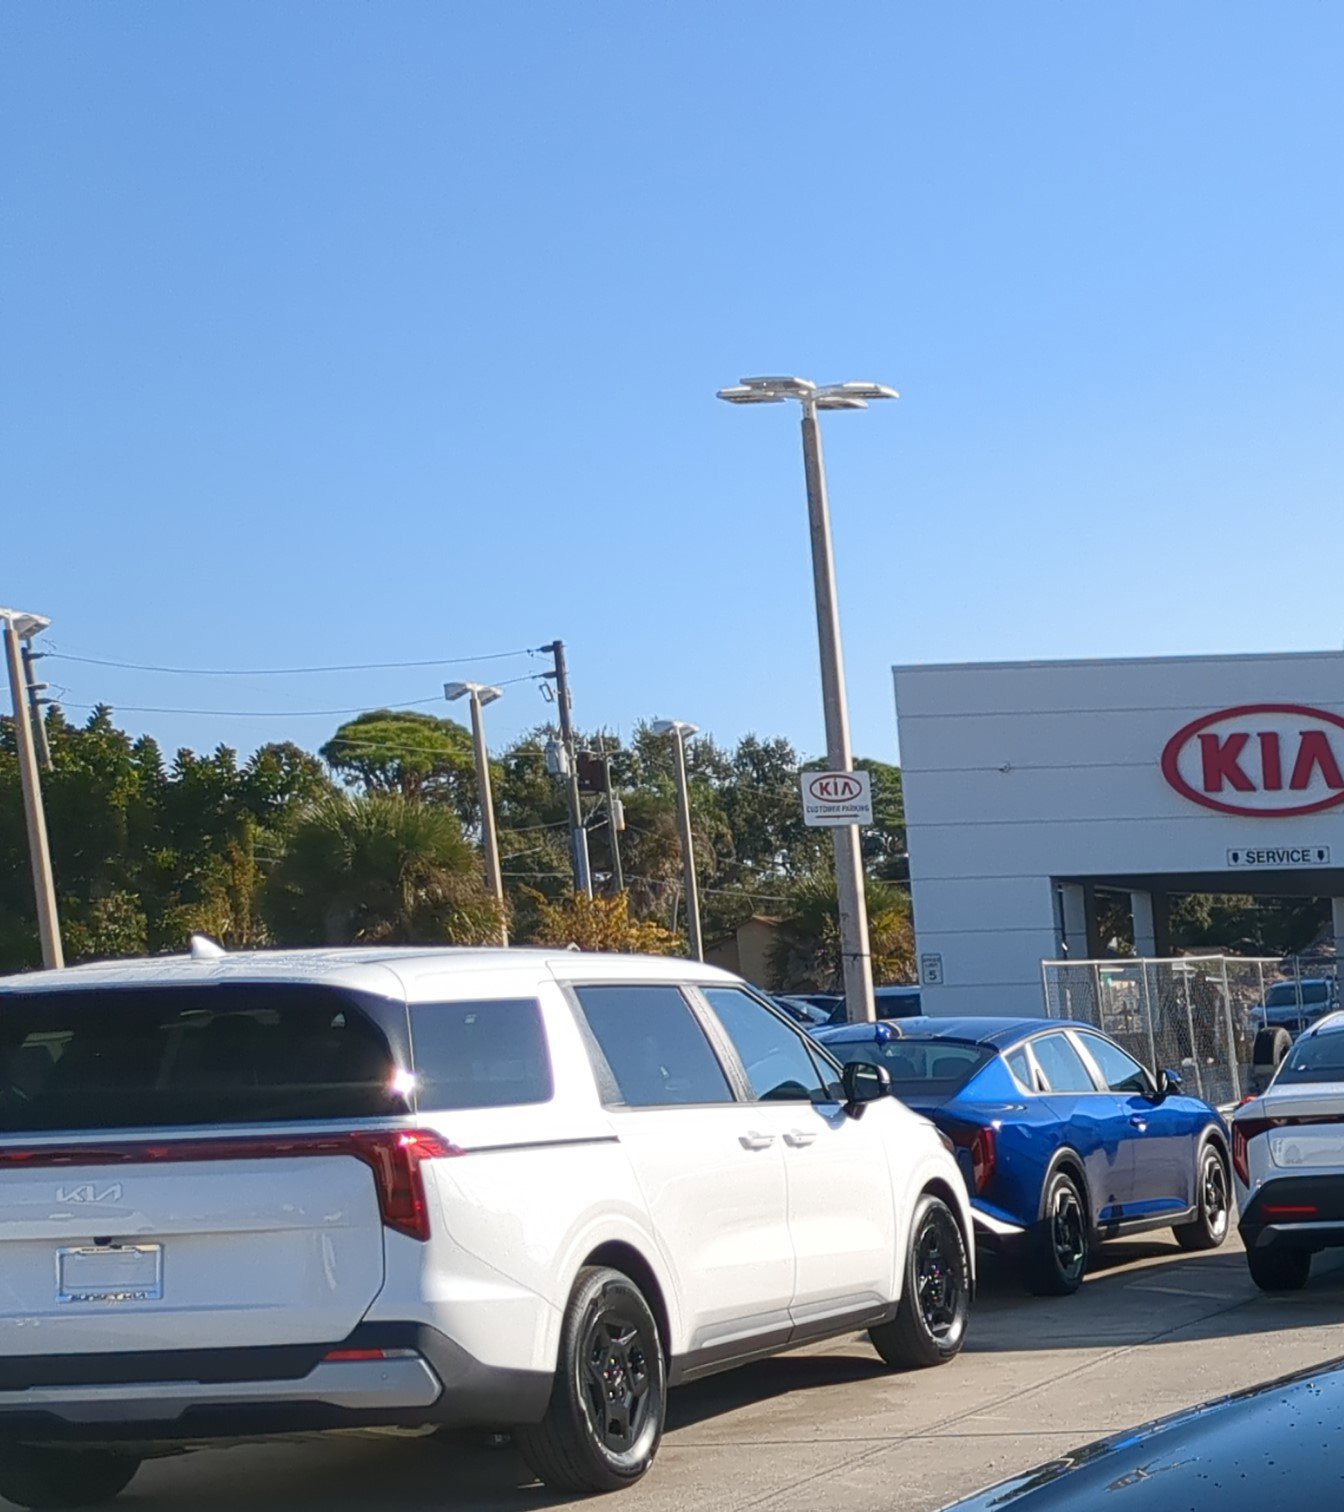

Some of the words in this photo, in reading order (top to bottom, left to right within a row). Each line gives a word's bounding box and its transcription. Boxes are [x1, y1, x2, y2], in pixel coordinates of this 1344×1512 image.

[819, 781, 854, 796] KIA
[806, 805, 840, 813] CUSTOMER
[841, 804, 870, 812] PARKING
[1245, 850, 1312, 864] SERVICE
[56, 1182, 123, 1202] KIA
